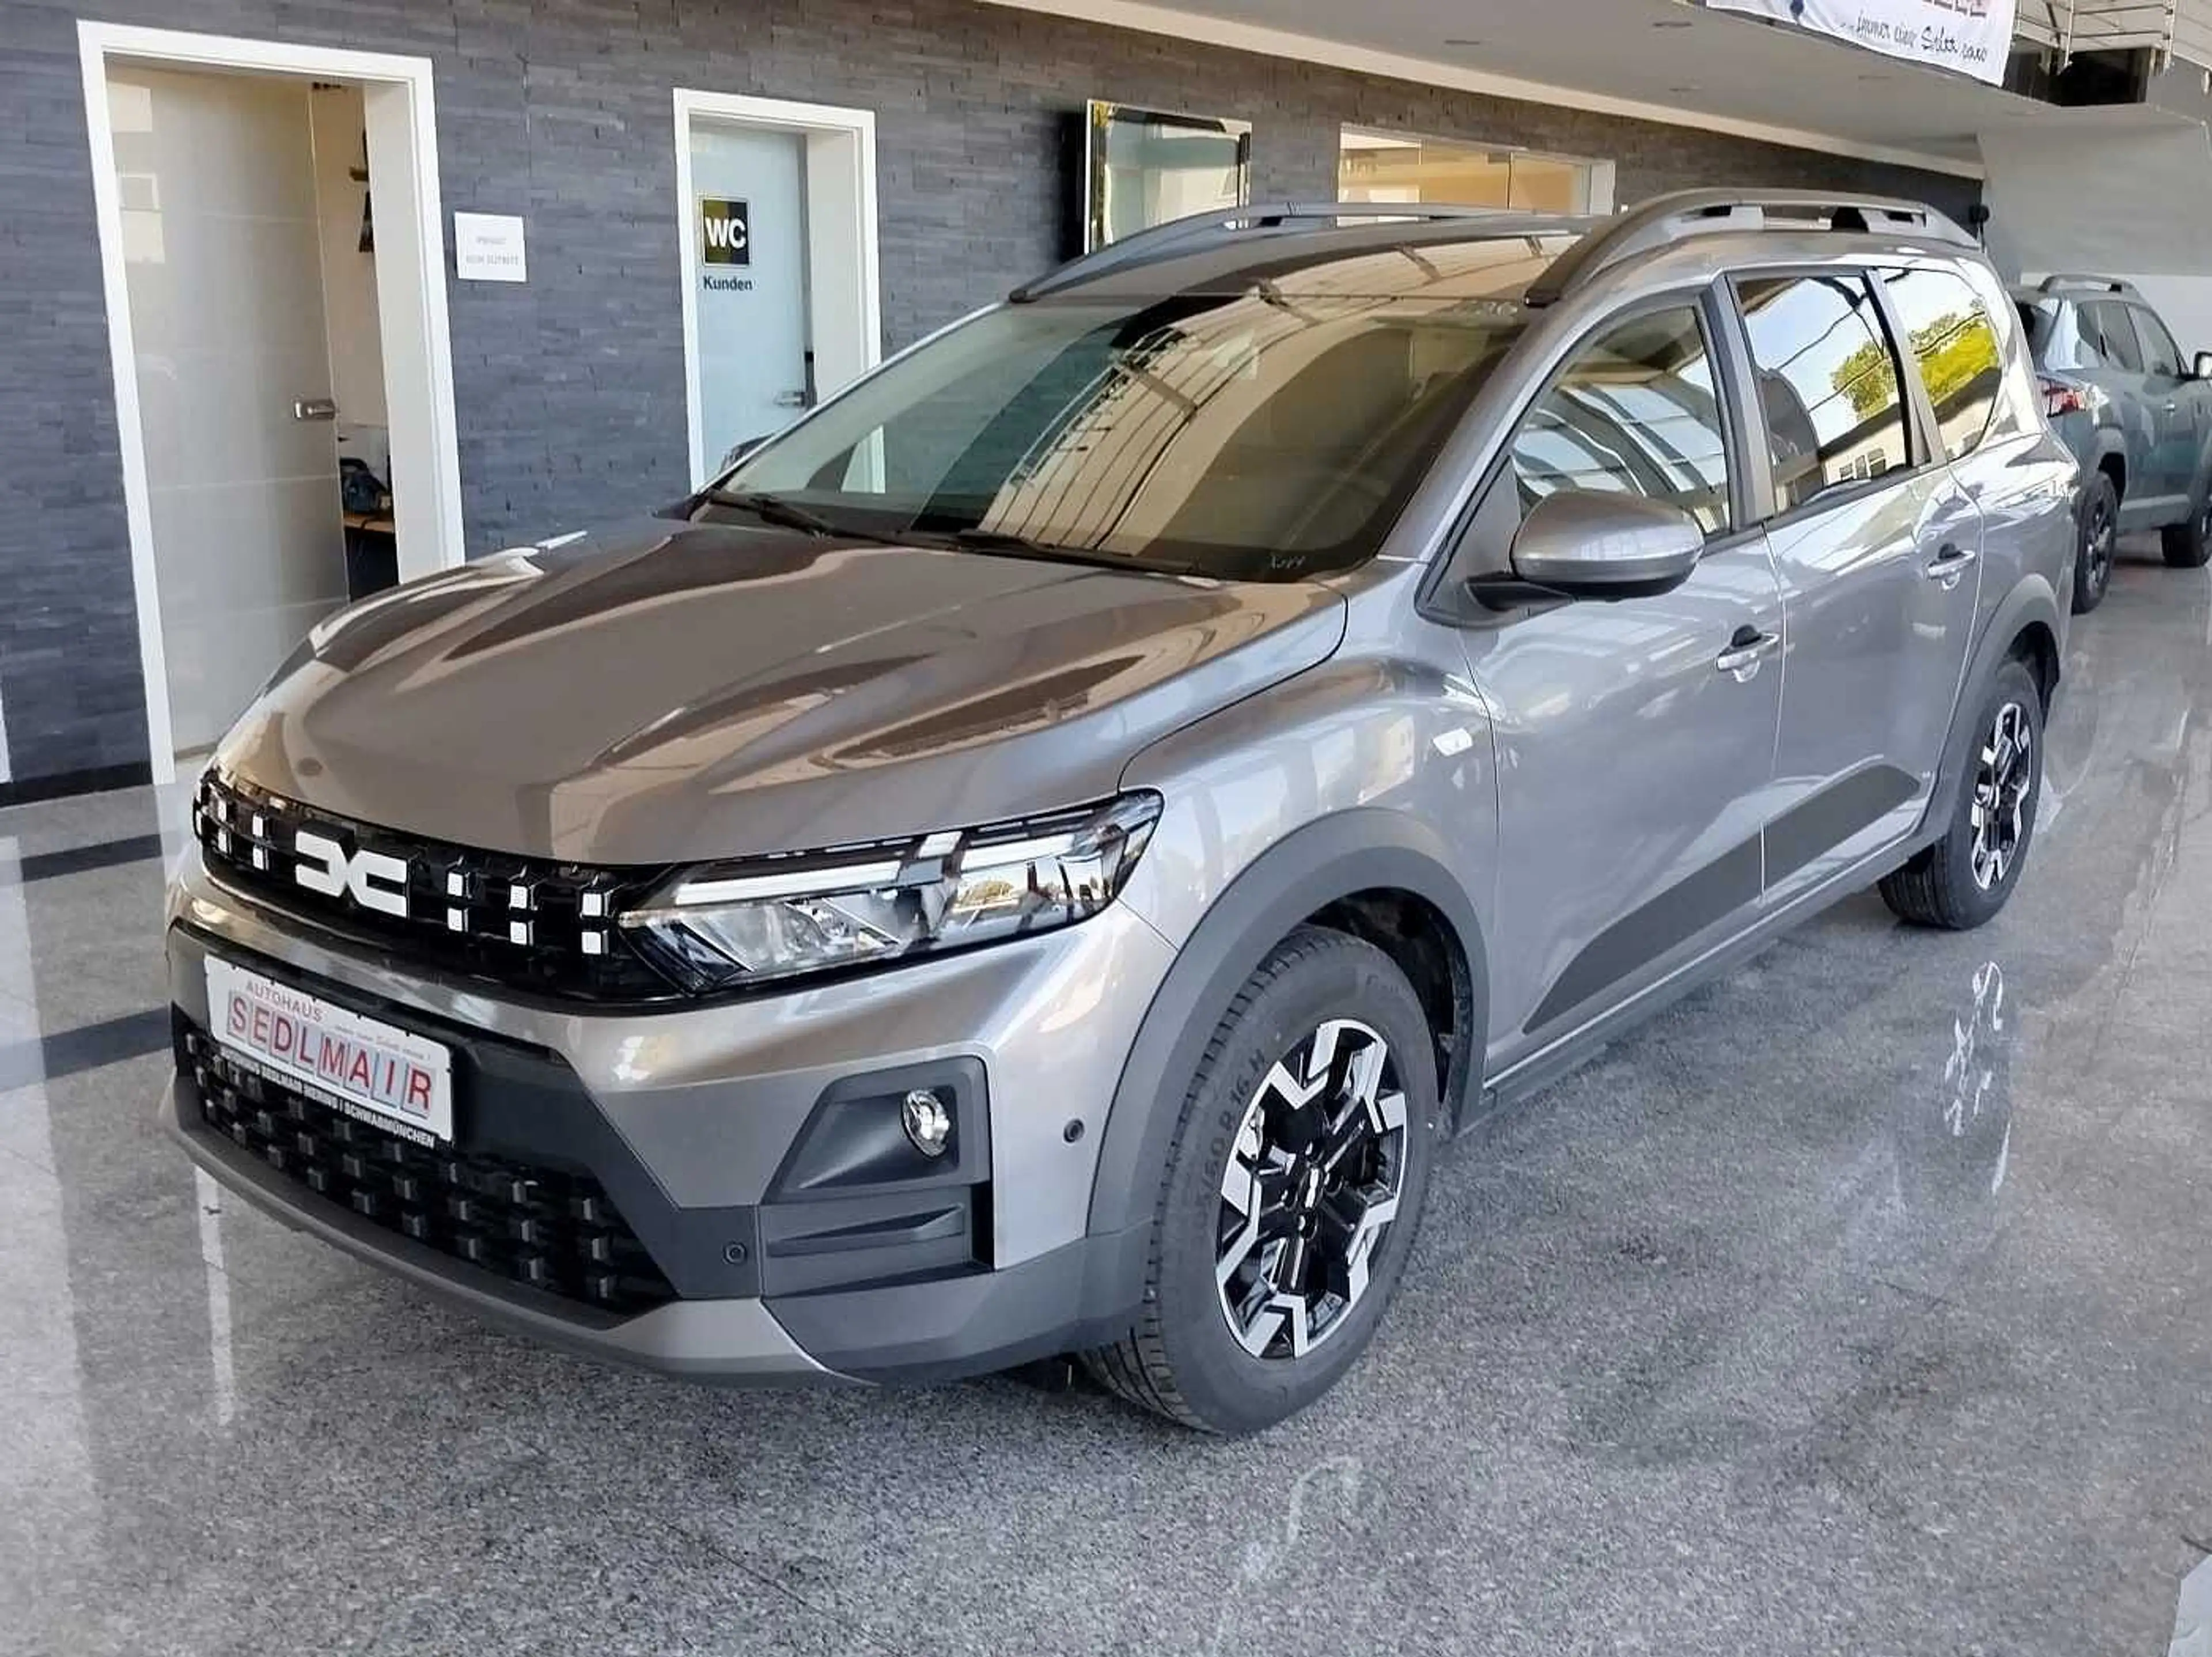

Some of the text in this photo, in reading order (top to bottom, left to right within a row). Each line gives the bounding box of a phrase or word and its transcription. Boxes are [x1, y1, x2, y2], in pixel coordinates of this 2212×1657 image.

[704, 217, 747, 249] WC
[703, 275, 753, 291] Kunden
[247, 980, 323, 1022] AUTOHAUS
[232, 996, 431, 1110] SEDLMAIR
